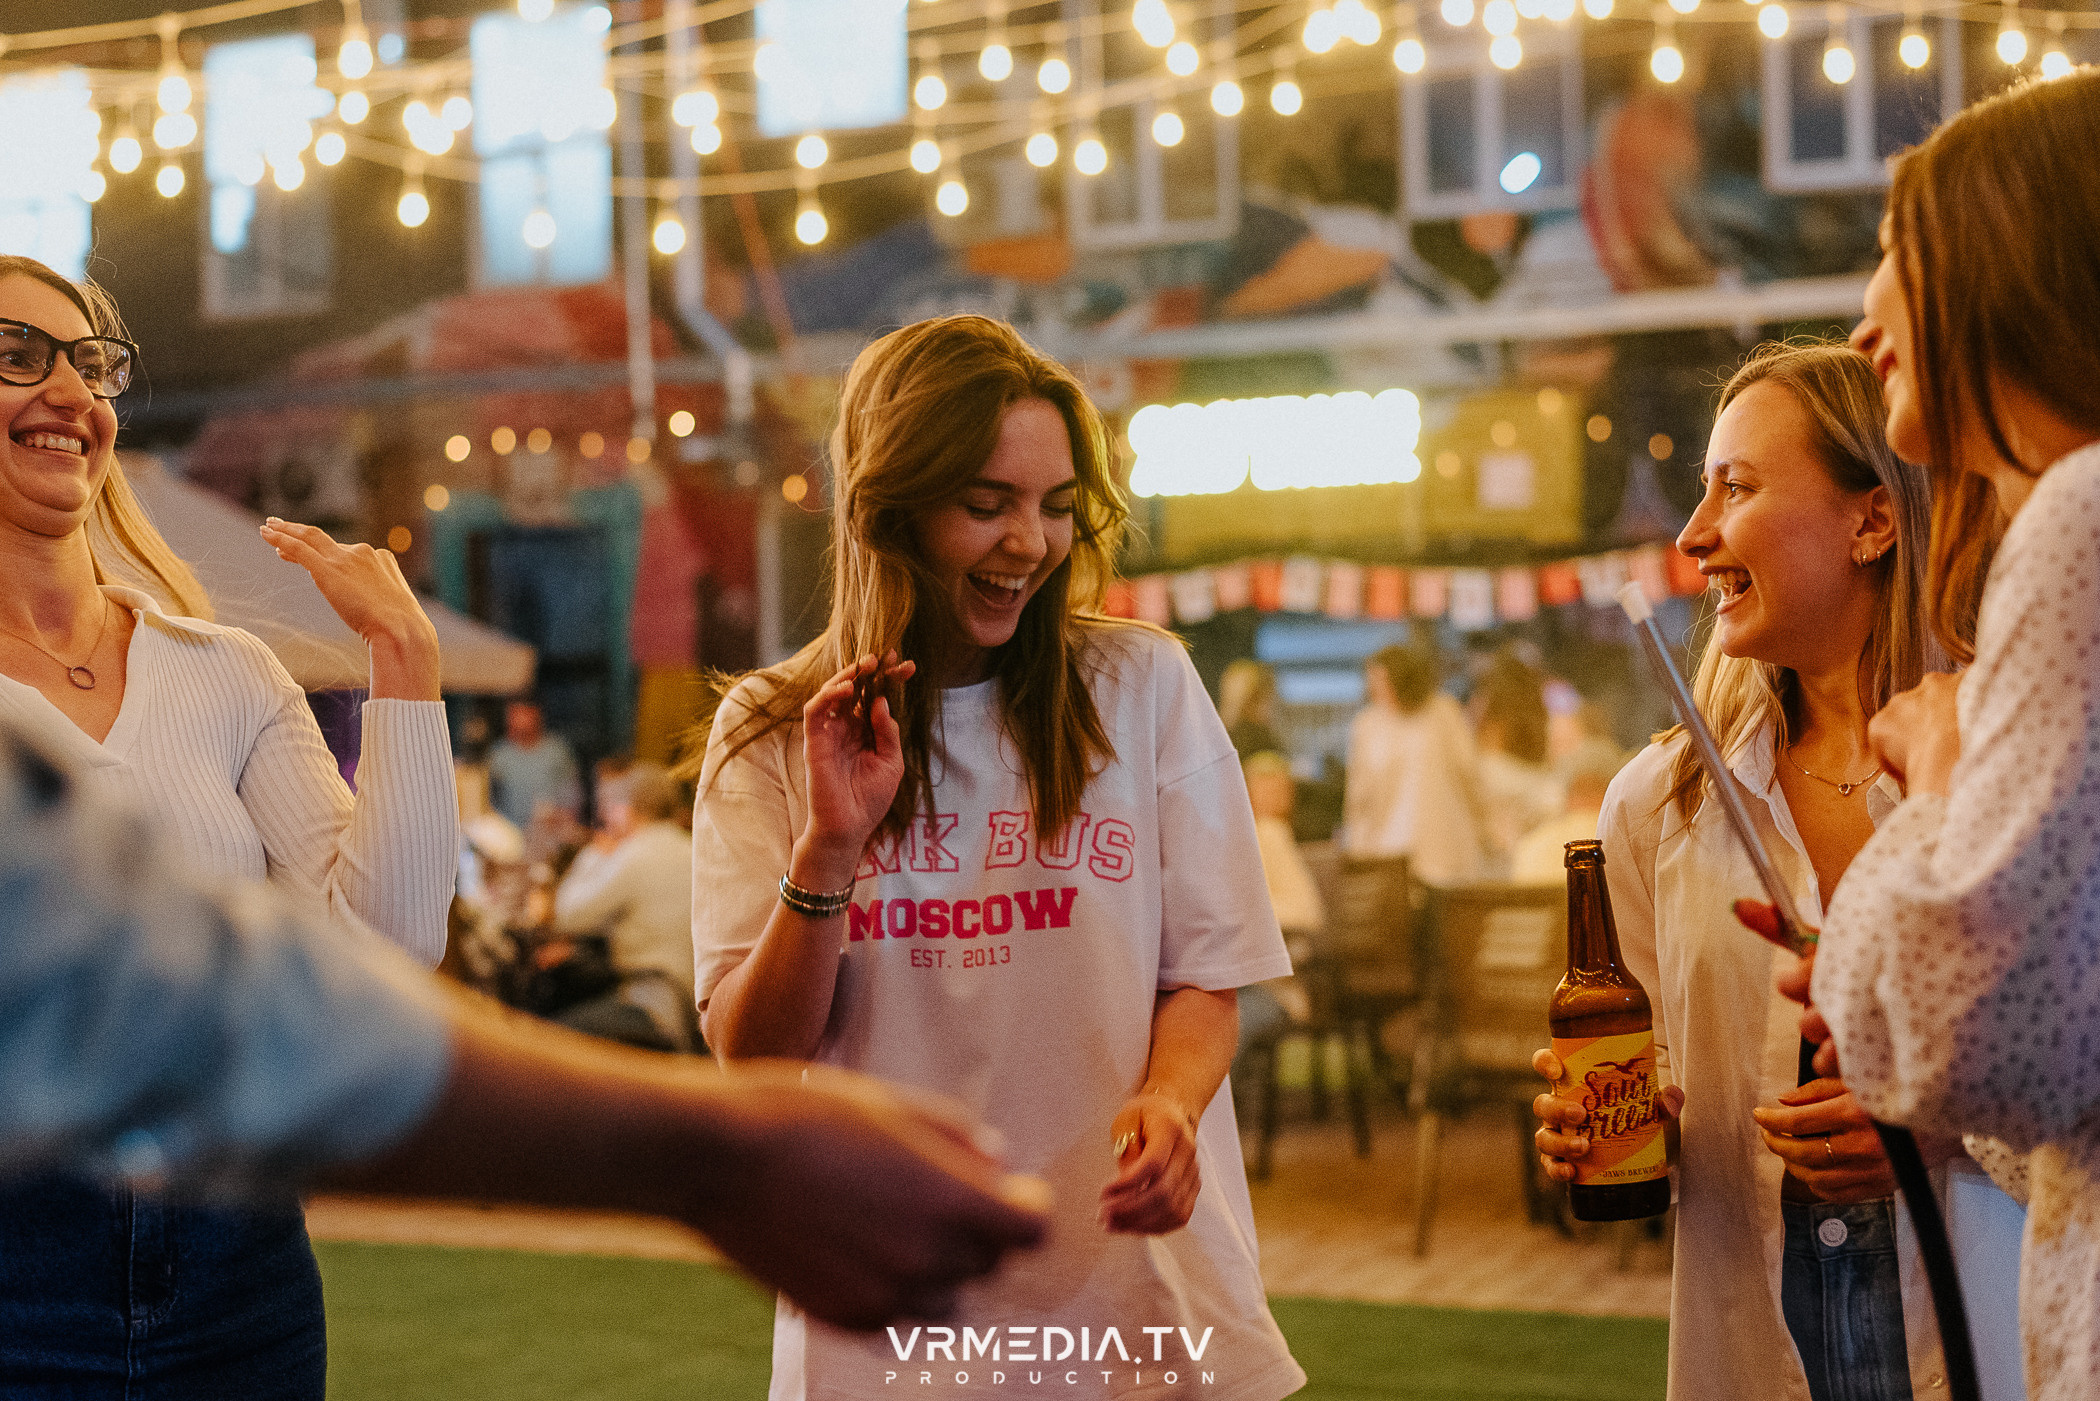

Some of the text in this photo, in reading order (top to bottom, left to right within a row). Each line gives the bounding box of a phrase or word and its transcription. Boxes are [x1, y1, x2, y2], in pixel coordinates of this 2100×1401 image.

[985, 810, 1135, 883] BUS
[849, 887, 1078, 941] MOSCOW
[910, 946, 1011, 968] EST. 2013
[1582, 1070, 1650, 1111] Sour
